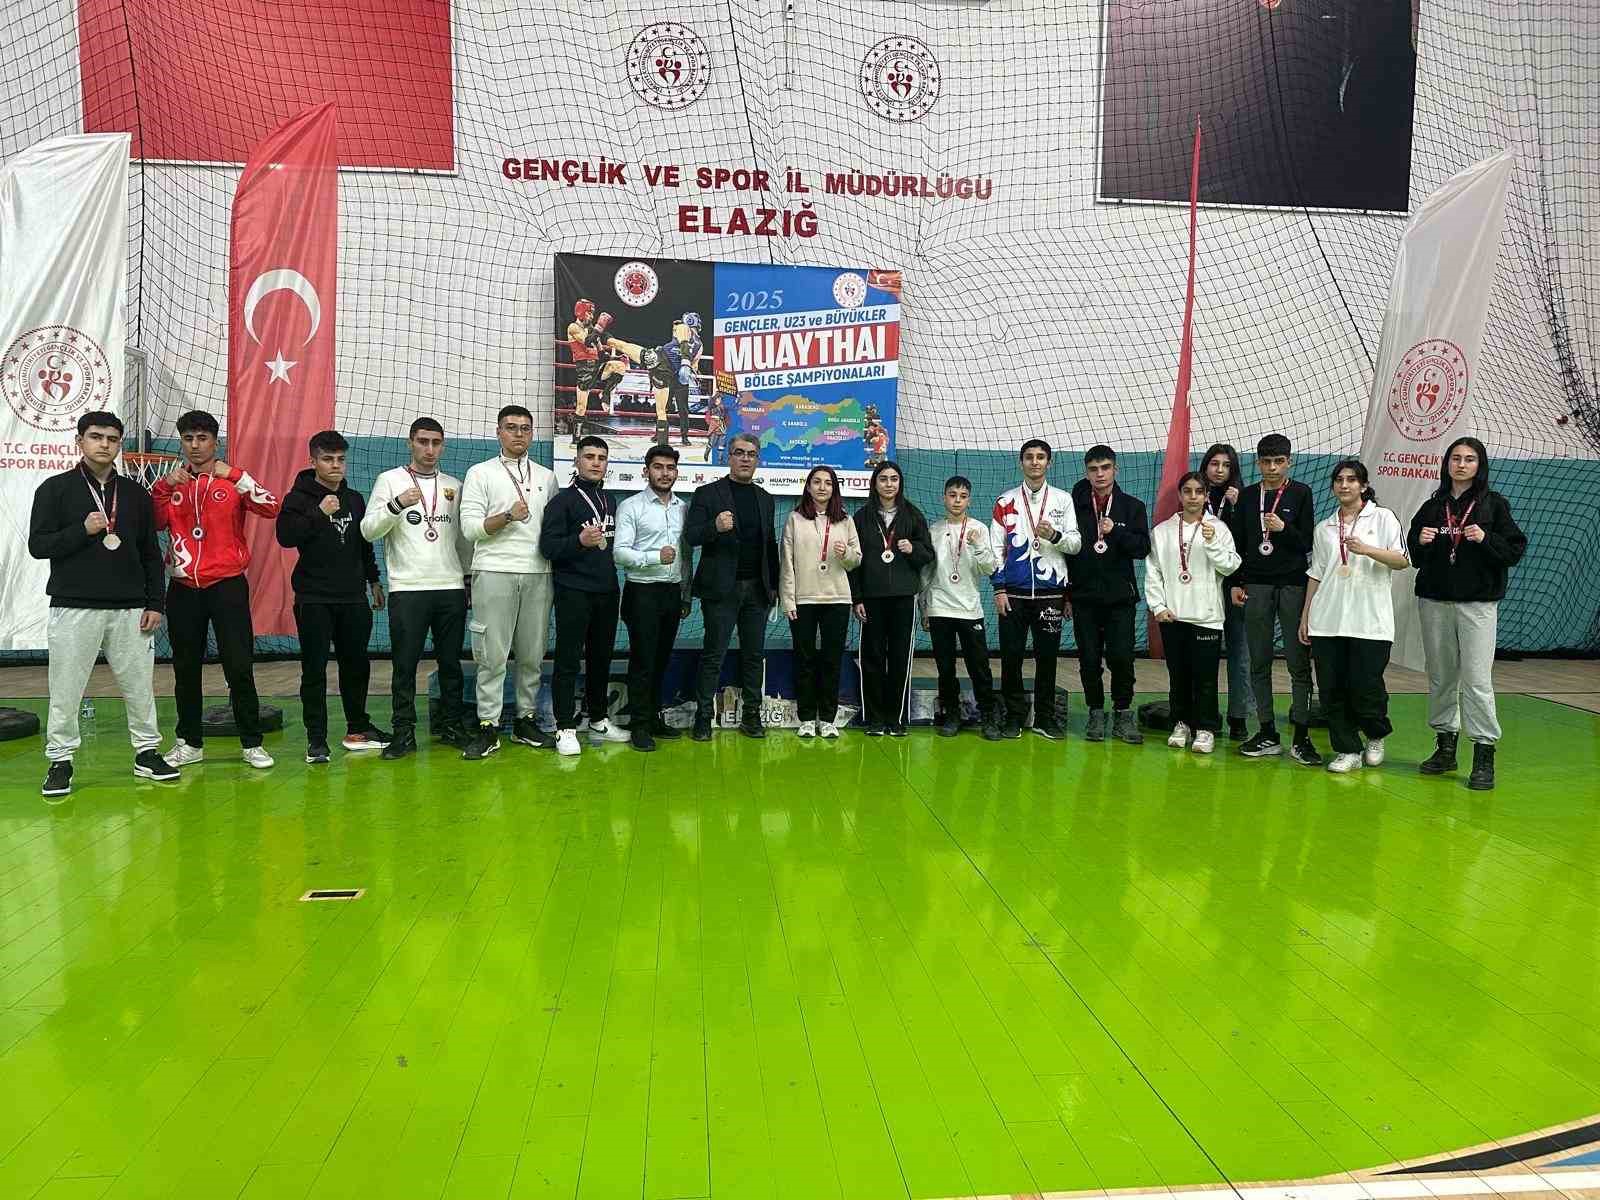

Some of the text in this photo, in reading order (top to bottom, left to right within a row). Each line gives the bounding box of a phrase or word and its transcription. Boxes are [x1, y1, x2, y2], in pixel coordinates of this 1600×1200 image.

[502, 156, 627, 187] GENÇLİK
[643, 164, 680, 188] VE
[696, 167, 770, 192] SPOR
[678, 201, 818, 238] ELAZIĞ
[726, 289, 784, 312] 2025
[784, 315, 806, 329] U23
[809, 316, 822, 327] ve
[825, 308, 887, 325] BÜYÜKLER
[723, 325, 886, 373] MUAYTHAI
[744, 371, 783, 389] BÖLGE
[4, 442, 27, 454] T.C.
[0, 458, 80, 470] SPOR BAKA
[1398, 453, 1440, 467] GENÇLİK
[1377, 465, 1400, 477] SPOR
